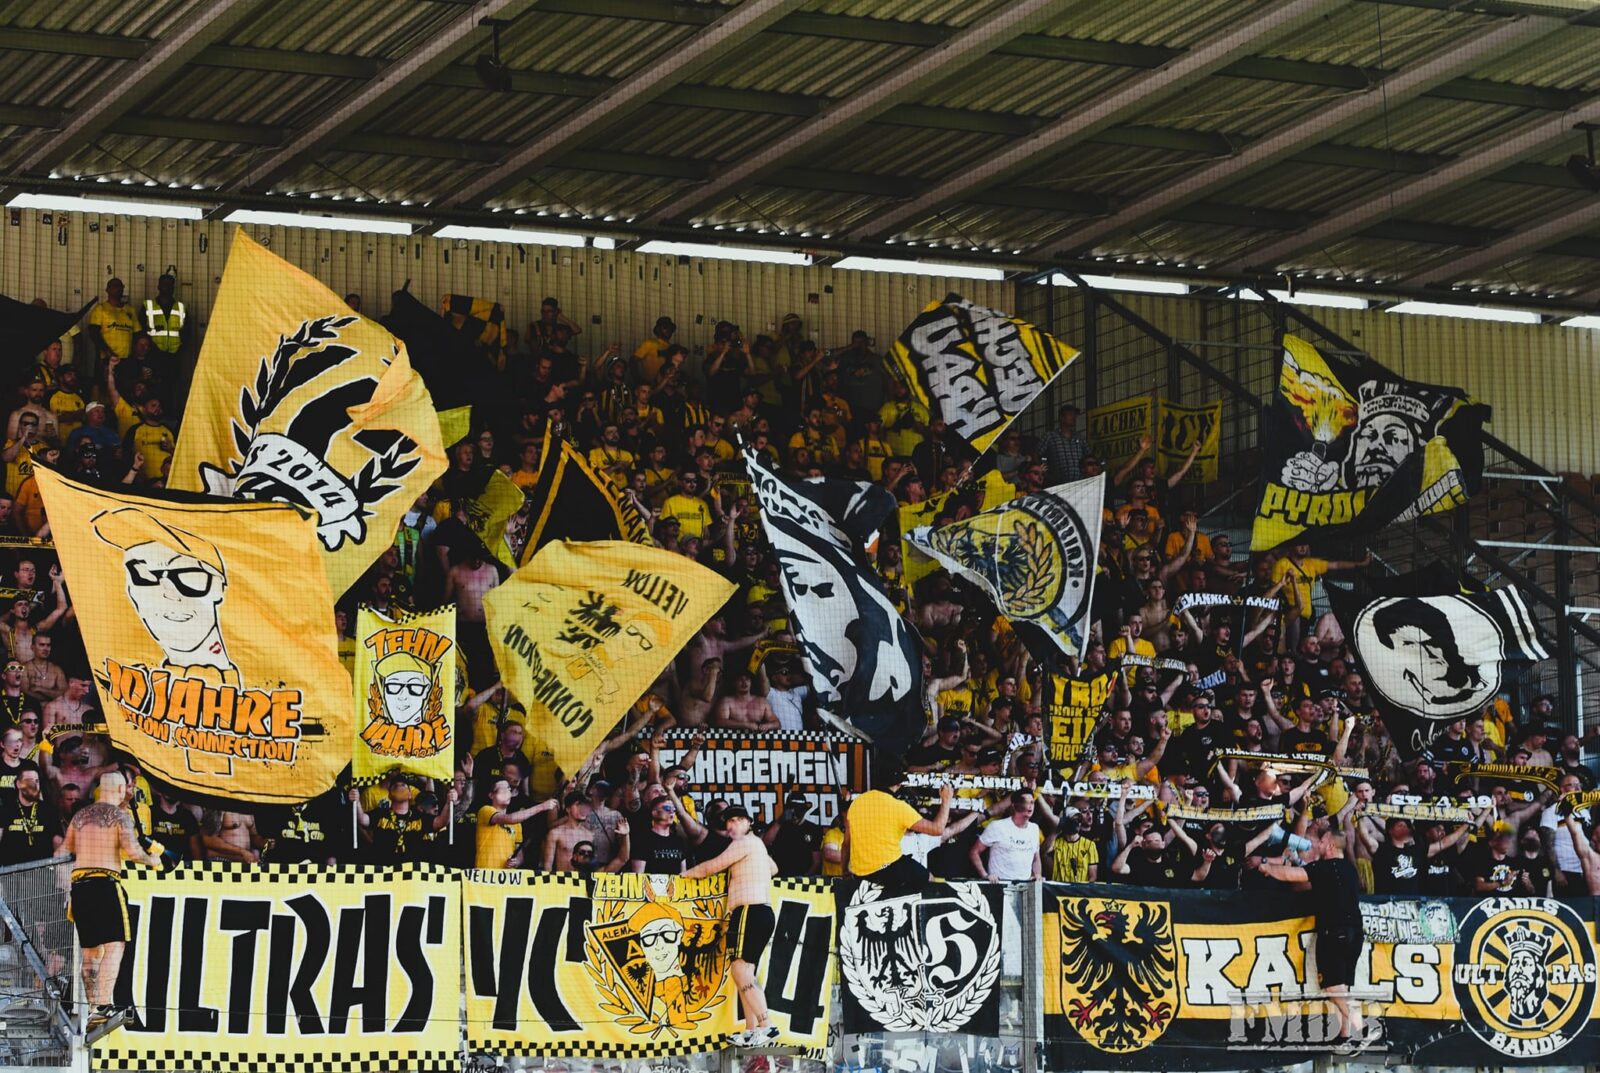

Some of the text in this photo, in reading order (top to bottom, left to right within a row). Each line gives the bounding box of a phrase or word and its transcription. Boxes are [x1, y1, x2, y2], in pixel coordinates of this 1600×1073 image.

[270, 448, 348, 510] 2014
[106, 657, 304, 740] 10 JAHRE
[175, 727, 296, 763] CONNECTION
[464, 868, 523, 886] YELLOW
[593, 872, 643, 900] ZEHN
[112, 893, 447, 1035] ULTRAS
[1550, 963, 1597, 985] RAS
[1490, 1029, 1568, 1056] BANDE
